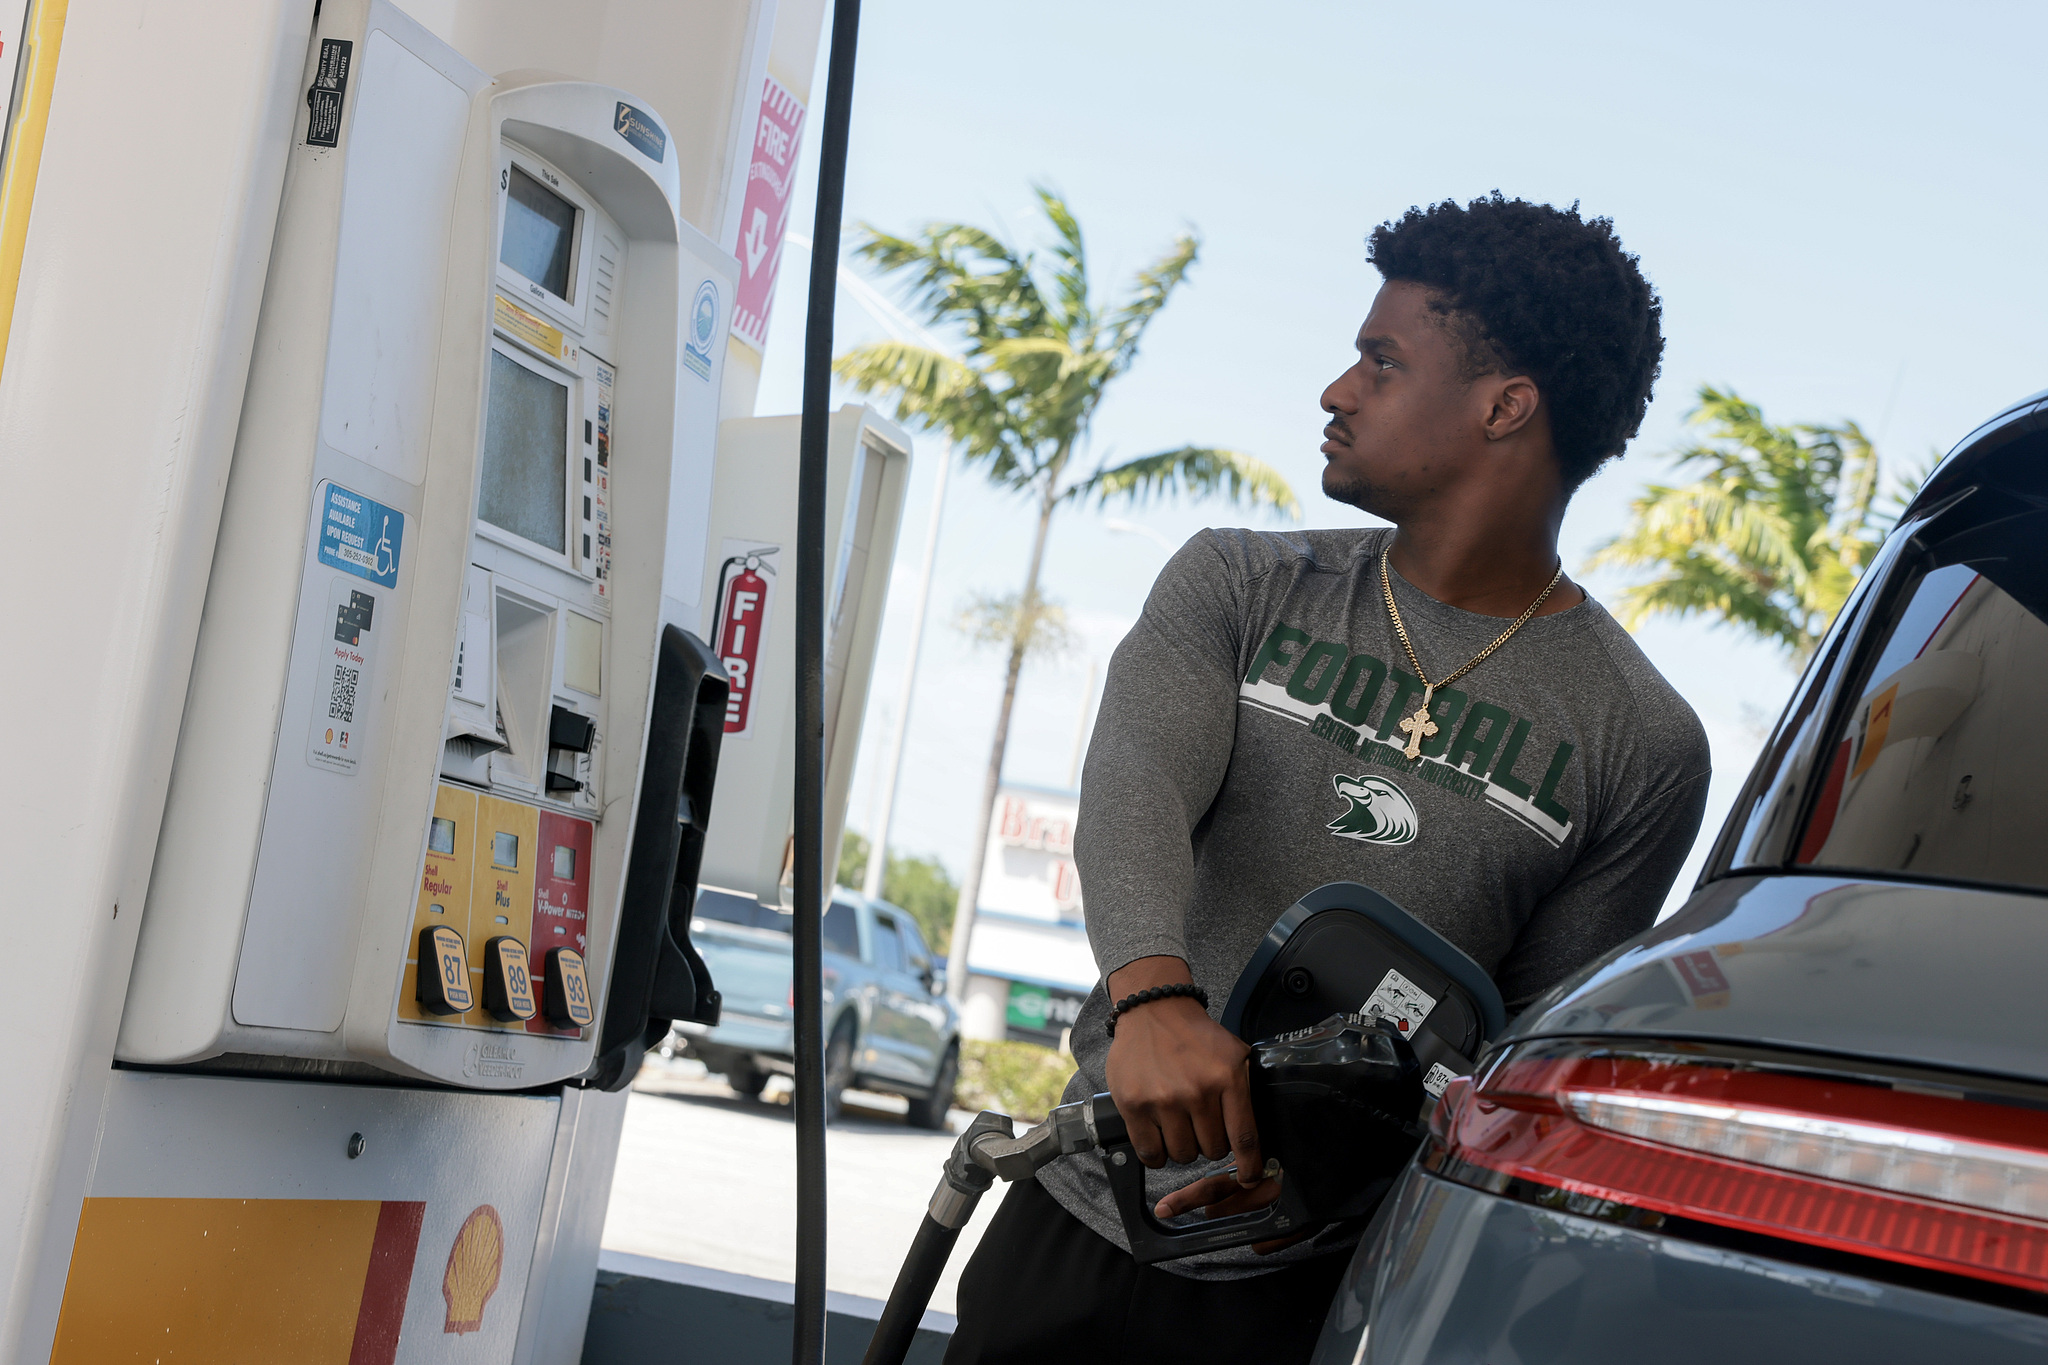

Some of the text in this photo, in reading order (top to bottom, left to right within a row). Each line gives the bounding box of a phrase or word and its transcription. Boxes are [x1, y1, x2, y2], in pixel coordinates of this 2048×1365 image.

[317, 60, 327, 87] SECURITY
[629, 117, 664, 149] SUNSHINE
[757, 114, 790, 167] FIRE
[501, 168, 508, 192] $
[529, 283, 545, 299] Gallons
[330, 492, 361, 514] ASSISTANCE
[328, 509, 356, 529] AVAILABLE
[326, 524, 364, 549] UPON REQUEST
[334, 646, 364, 666] Apply Today
[1245, 621, 1575, 828] FOOTBALL
[1310, 712, 1490, 801] CENTRAL METHODIST UNIVERSITY
[425, 864, 438, 876] Shell
[423, 876, 452, 897] Regular
[496, 880, 508, 891] Shell
[537, 888, 549, 900] Shell
[495, 891, 510, 908] Plus
[537, 899, 565, 917] V-Power
[443, 954, 461, 986] 87
[508, 964, 527, 995] 89
[566, 973, 585, 1004] 93
